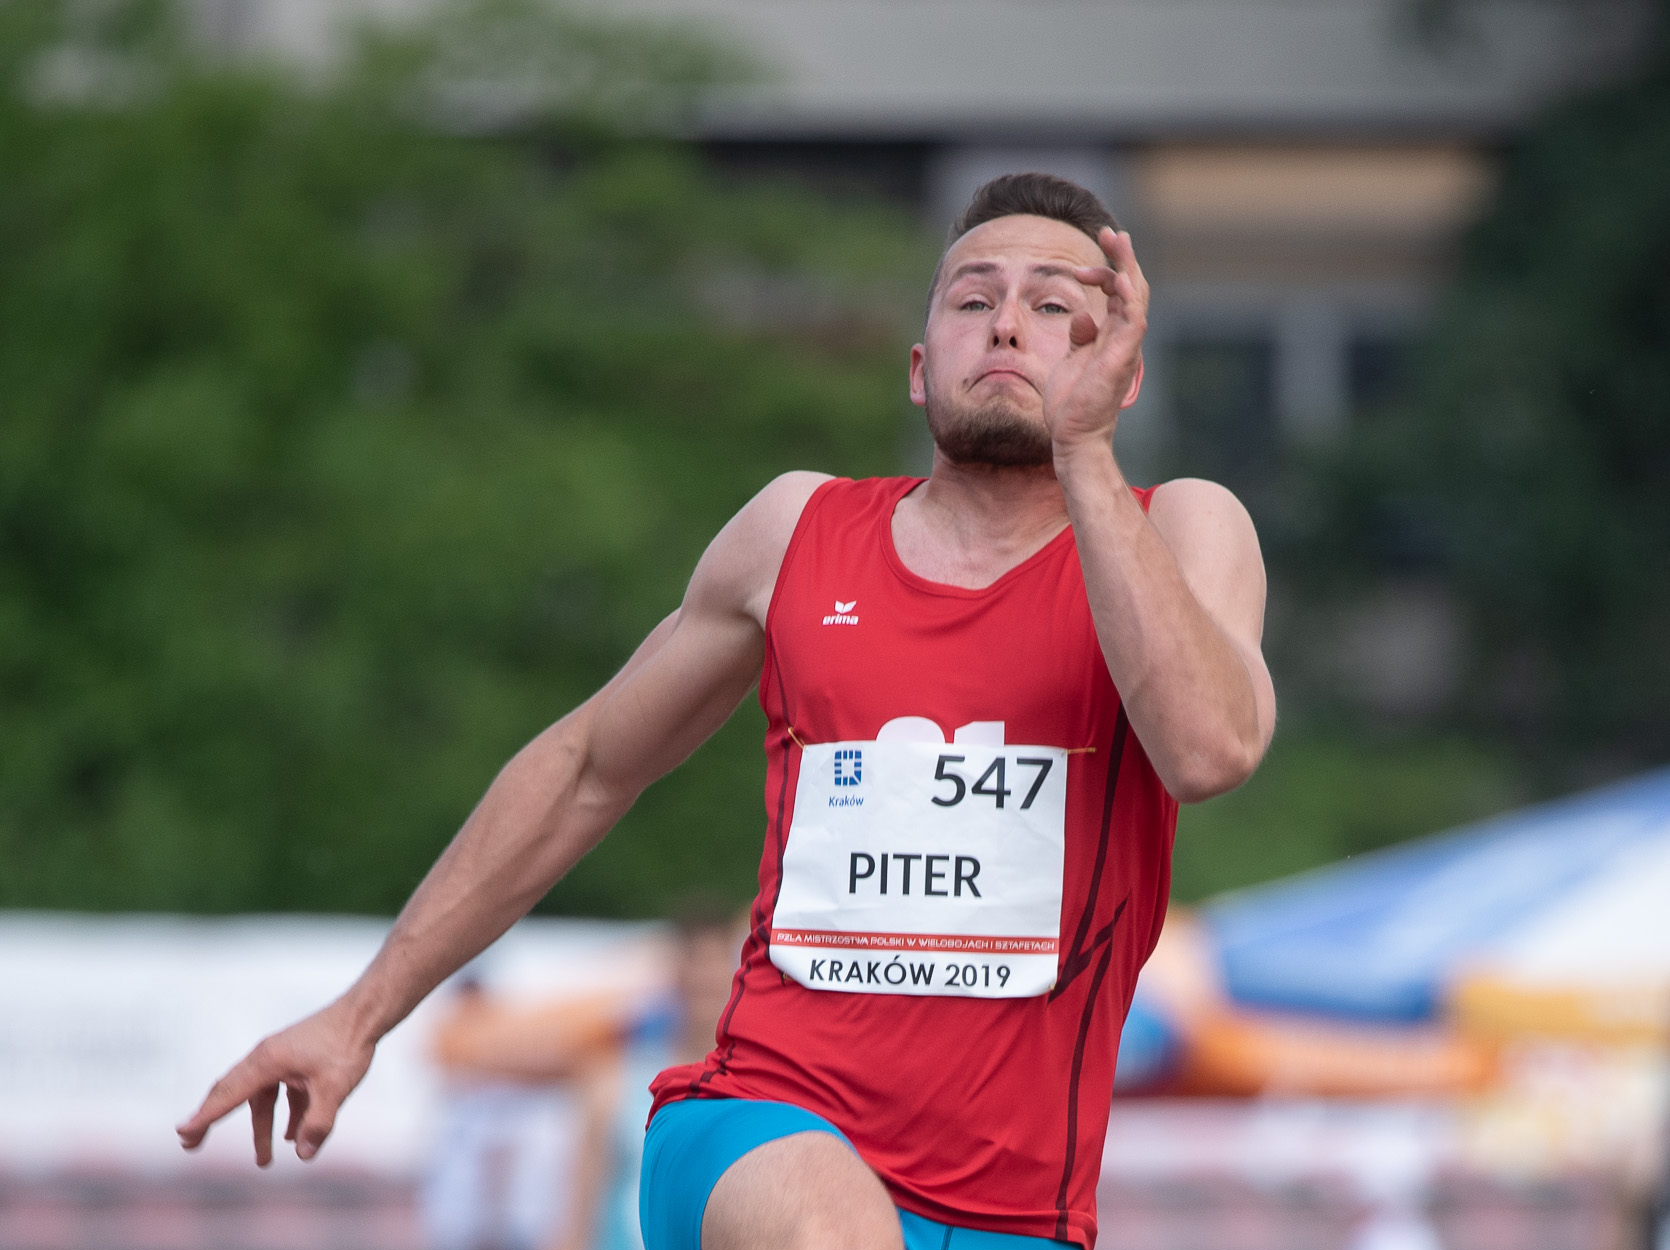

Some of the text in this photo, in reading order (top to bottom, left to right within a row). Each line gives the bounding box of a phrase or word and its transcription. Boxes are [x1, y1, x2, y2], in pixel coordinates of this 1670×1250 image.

[822, 614, 859, 626] erima
[931, 754, 1053, 810] 547
[828, 795, 864, 807] Kraków
[849, 853, 982, 898] PITER
[777, 932, 802, 943] PZLA
[803, 934, 869, 946] MISTRZOSTWA
[870, 936, 905, 947] POLSKI
[906, 938, 917, 948] W
[918, 938, 989, 950] WIELOBOJACH
[995, 940, 1055, 951] SZTAFETACH
[809, 954, 1011, 988] KRAKÓW 2019
